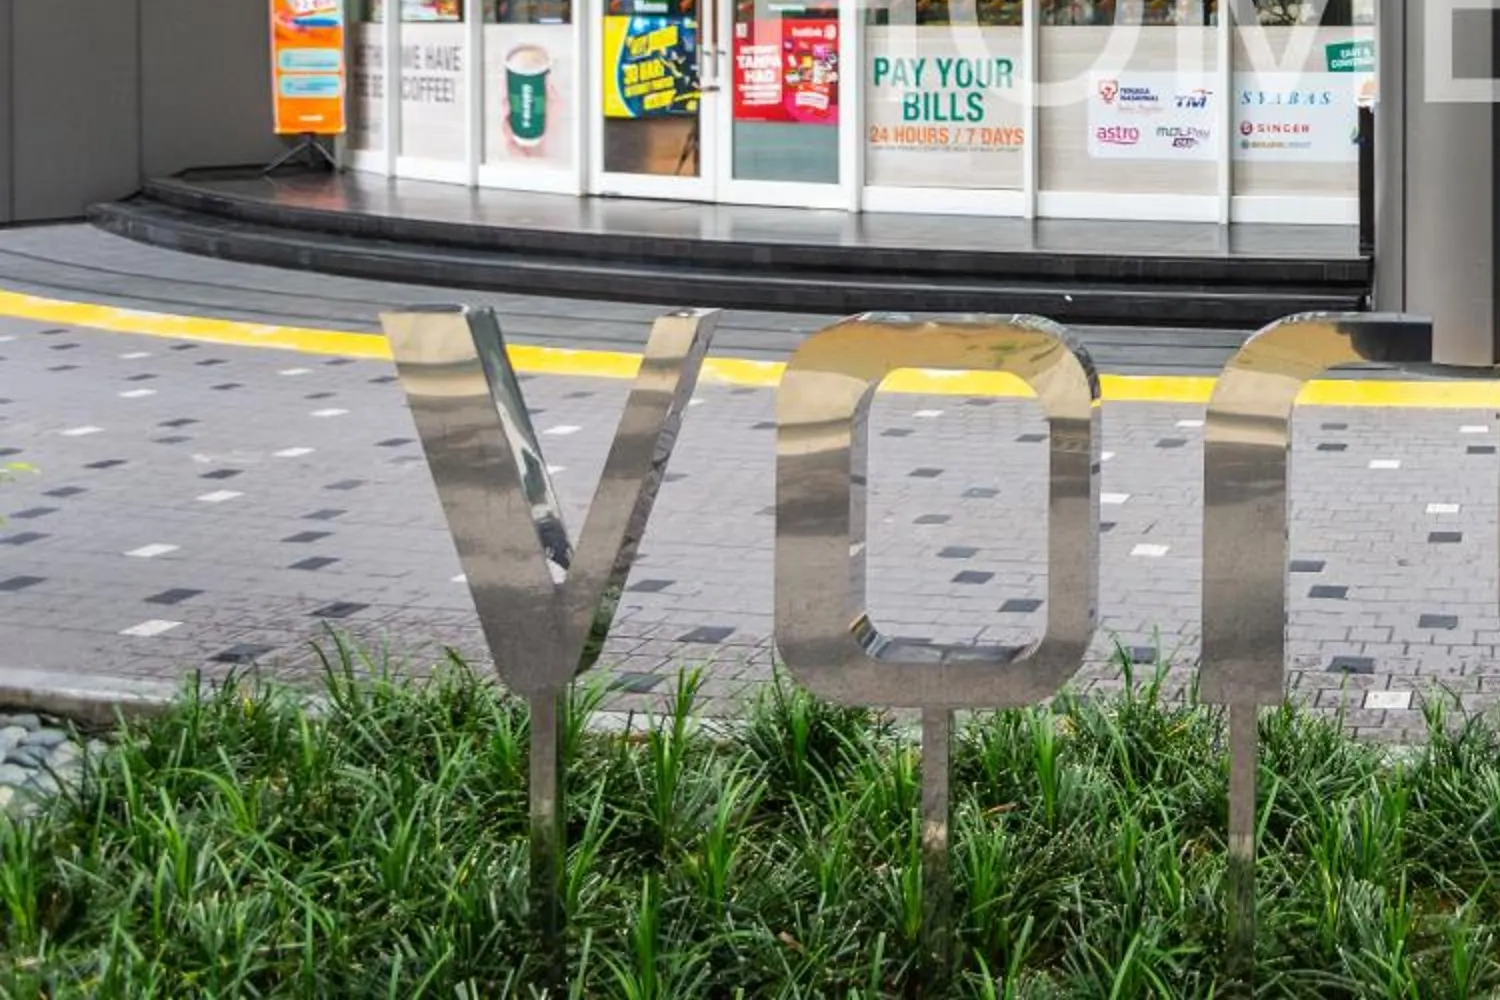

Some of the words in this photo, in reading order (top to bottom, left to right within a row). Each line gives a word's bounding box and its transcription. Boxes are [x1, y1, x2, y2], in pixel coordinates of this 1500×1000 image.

[873, 57, 926, 87] PAY
[936, 57, 1014, 89] YOUR
[903, 91, 985, 122] BILLS
[870, 125, 888, 143] 24
[895, 126, 949, 145] HOURS
[954, 127, 962, 144] /
[966, 127, 976, 145] 7
[981, 127, 1025, 146] DAYS
[1097, 126, 1140, 140] astro
[1257, 123, 1310, 133] SINGER
